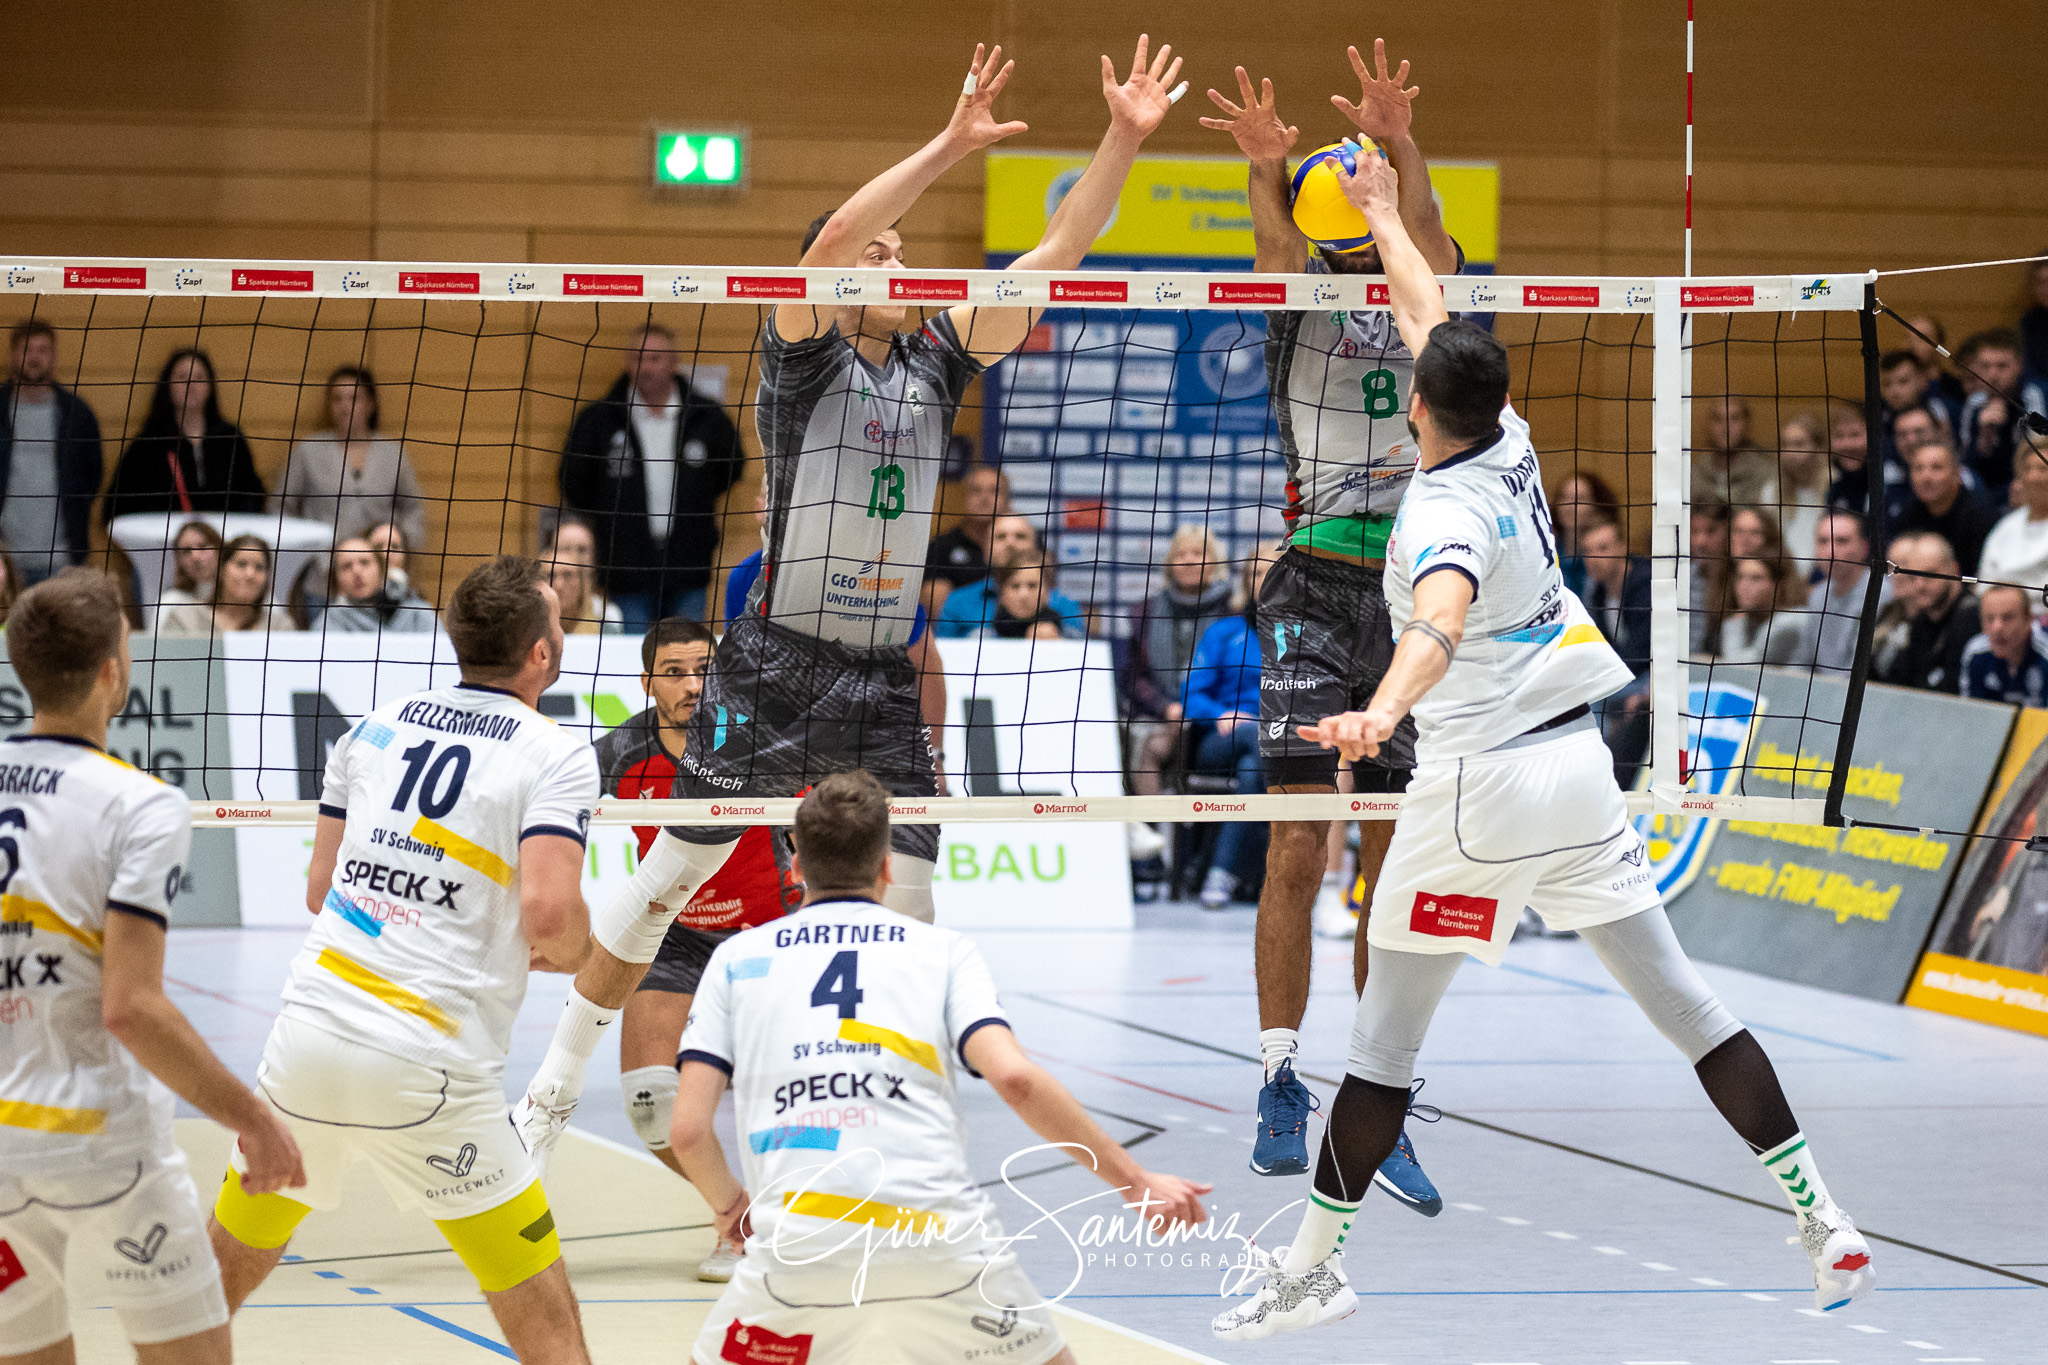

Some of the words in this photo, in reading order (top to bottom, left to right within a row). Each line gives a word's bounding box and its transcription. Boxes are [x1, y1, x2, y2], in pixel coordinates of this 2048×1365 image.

[15, 276, 36, 286] Zapf
[81, 276, 111, 286] Sparkasse
[112, 276, 142, 286] Nürnberg
[182, 278, 203, 288] Zapf
[248, 279, 280, 289] Sparkasse
[279, 279, 309, 289] Nürnberg
[349, 280, 370, 290] Zapf
[415, 281, 445, 291] Sparkasse
[446, 281, 475, 291] Nürnberg
[516, 282, 536, 292] Zapf
[578, 283, 610, 293] Sparkasse
[610, 283, 639, 293] Nürnberg
[680, 285, 700, 295] Zapf
[742, 285, 773, 295] Sparkasse
[773, 285, 802, 295] Nürnberg
[843, 287, 863, 296] Zapf
[904, 287, 935, 297] Sparkasse
[935, 287, 964, 297] Nürnberg
[1801, 287, 1830, 297] HUCK
[1003, 289, 1022, 299] Zapf
[1064, 289, 1095, 299] Sparkasse
[1095, 289, 1124, 299] Nürnberg
[1163, 291, 1183, 301] Zapf
[1224, 291, 1254, 301] Sparkasse
[1254, 291, 1282, 301] Nürnberg
[1321, 292, 1341, 302] Zapf
[1478, 294, 1498, 304] Zapf
[1538, 293, 1568, 303] Sparkasse
[1568, 293, 1596, 303] Nürnberg
[1632, 295, 1653, 305] Zapf
[1693, 295, 1722, 305] Sparkasse
[1722, 295, 1750, 305] Nürnberg
[1361, 368, 1399, 420] 8
[867, 463, 905, 520] 13
[831, 573, 904, 591] GEOTHERMIE
[826, 591, 900, 609] UNTERHACHING
[398, 700, 521, 742] KELLERMANN
[390, 739, 471, 820] 10
[1045, 803, 1088, 814] Marmot
[1204, 801, 1247, 812] Marmot
[1362, 800, 1399, 811] Marmo
[1681, 799, 1714, 811] armot
[228, 808, 272, 818] Marmot
[722, 805, 766, 816] Marmot
[370, 827, 387, 844] SV
[388, 831, 446, 862] Schwaig
[341, 859, 430, 903] SPECK
[1439, 905, 1485, 921] Sparkasse
[1437, 917, 1480, 932] Nürnberg
[775, 922, 906, 948] GÄRTNER
[810, 950, 863, 1020] 4
[793, 1043, 811, 1060] SV
[816, 1039, 881, 1056] Schwaig
[774, 1072, 874, 1115] SPECK
